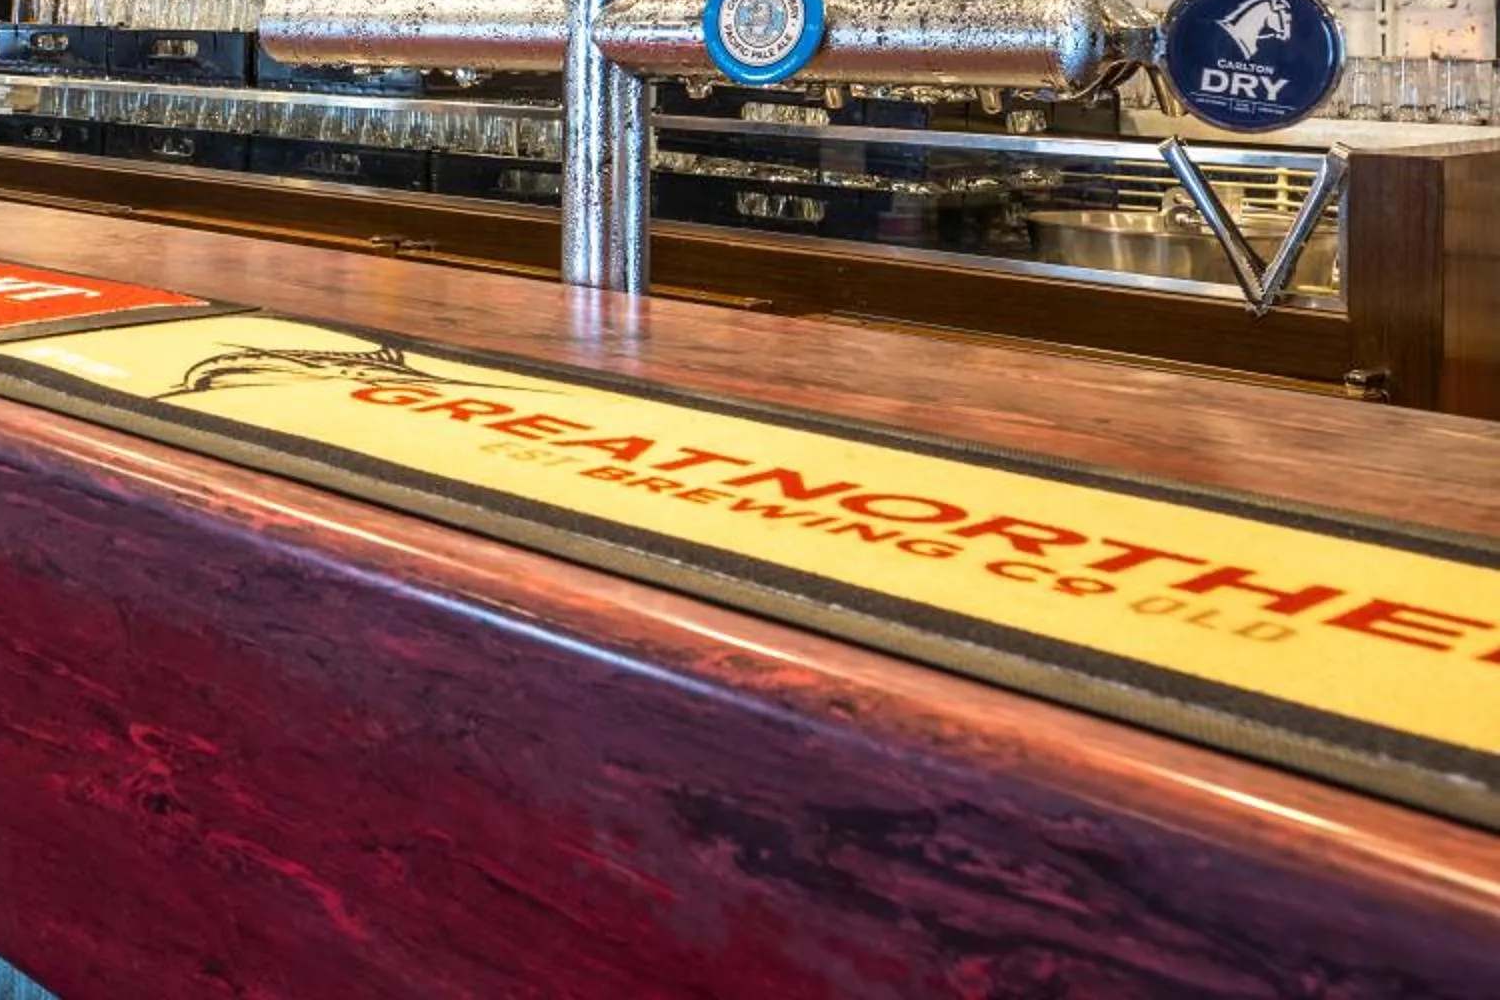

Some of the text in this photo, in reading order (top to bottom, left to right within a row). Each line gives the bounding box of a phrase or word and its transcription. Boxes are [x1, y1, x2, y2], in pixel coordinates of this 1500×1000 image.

[1200, 68, 1292, 101] DRY
[1217, 59, 1275, 75] CARLTON
[349, 385, 753, 473] GREAT
[579, 465, 965, 560] BREWING
